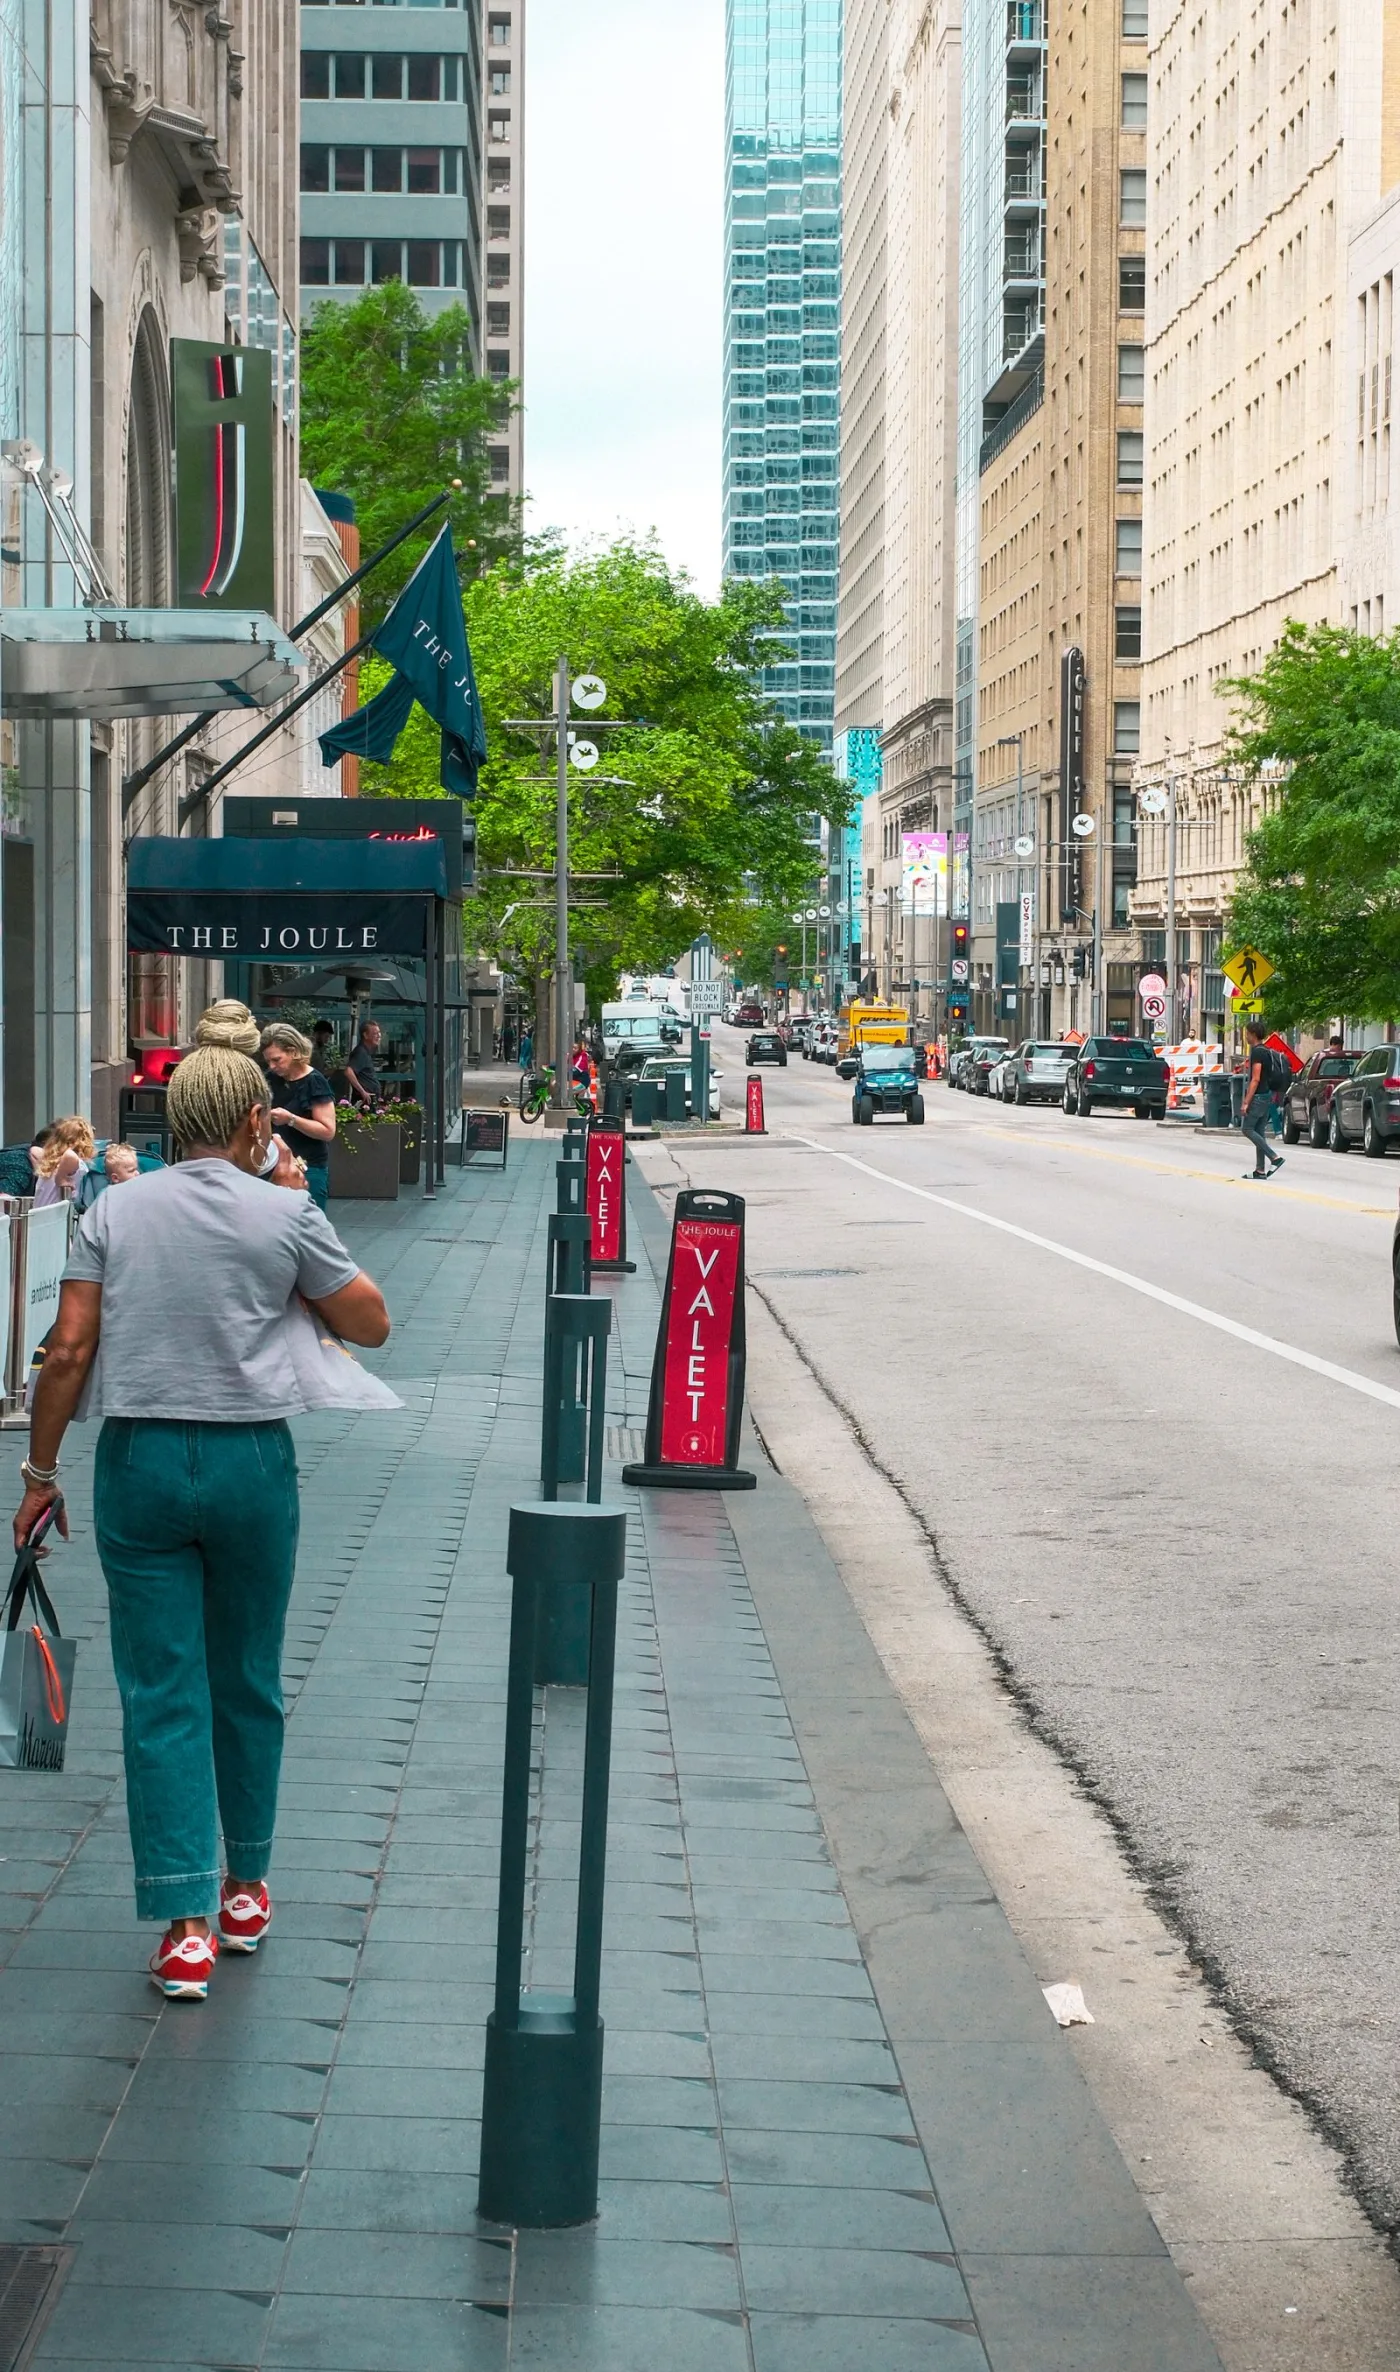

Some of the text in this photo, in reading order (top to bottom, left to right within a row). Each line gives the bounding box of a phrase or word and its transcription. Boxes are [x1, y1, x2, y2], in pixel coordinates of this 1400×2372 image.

[412, 620, 452, 669] THE
[1073, 673, 1082, 895] GULF STTES
[167, 926, 378, 949] THE JOULE
[693, 984, 719, 992] DO NOT
[694, 993, 718, 1001] BLOCK
[597, 1146, 612, 1238] VALET
[681, 1225, 736, 1237] THE JOULE
[687, 1248, 720, 1422] VALET
